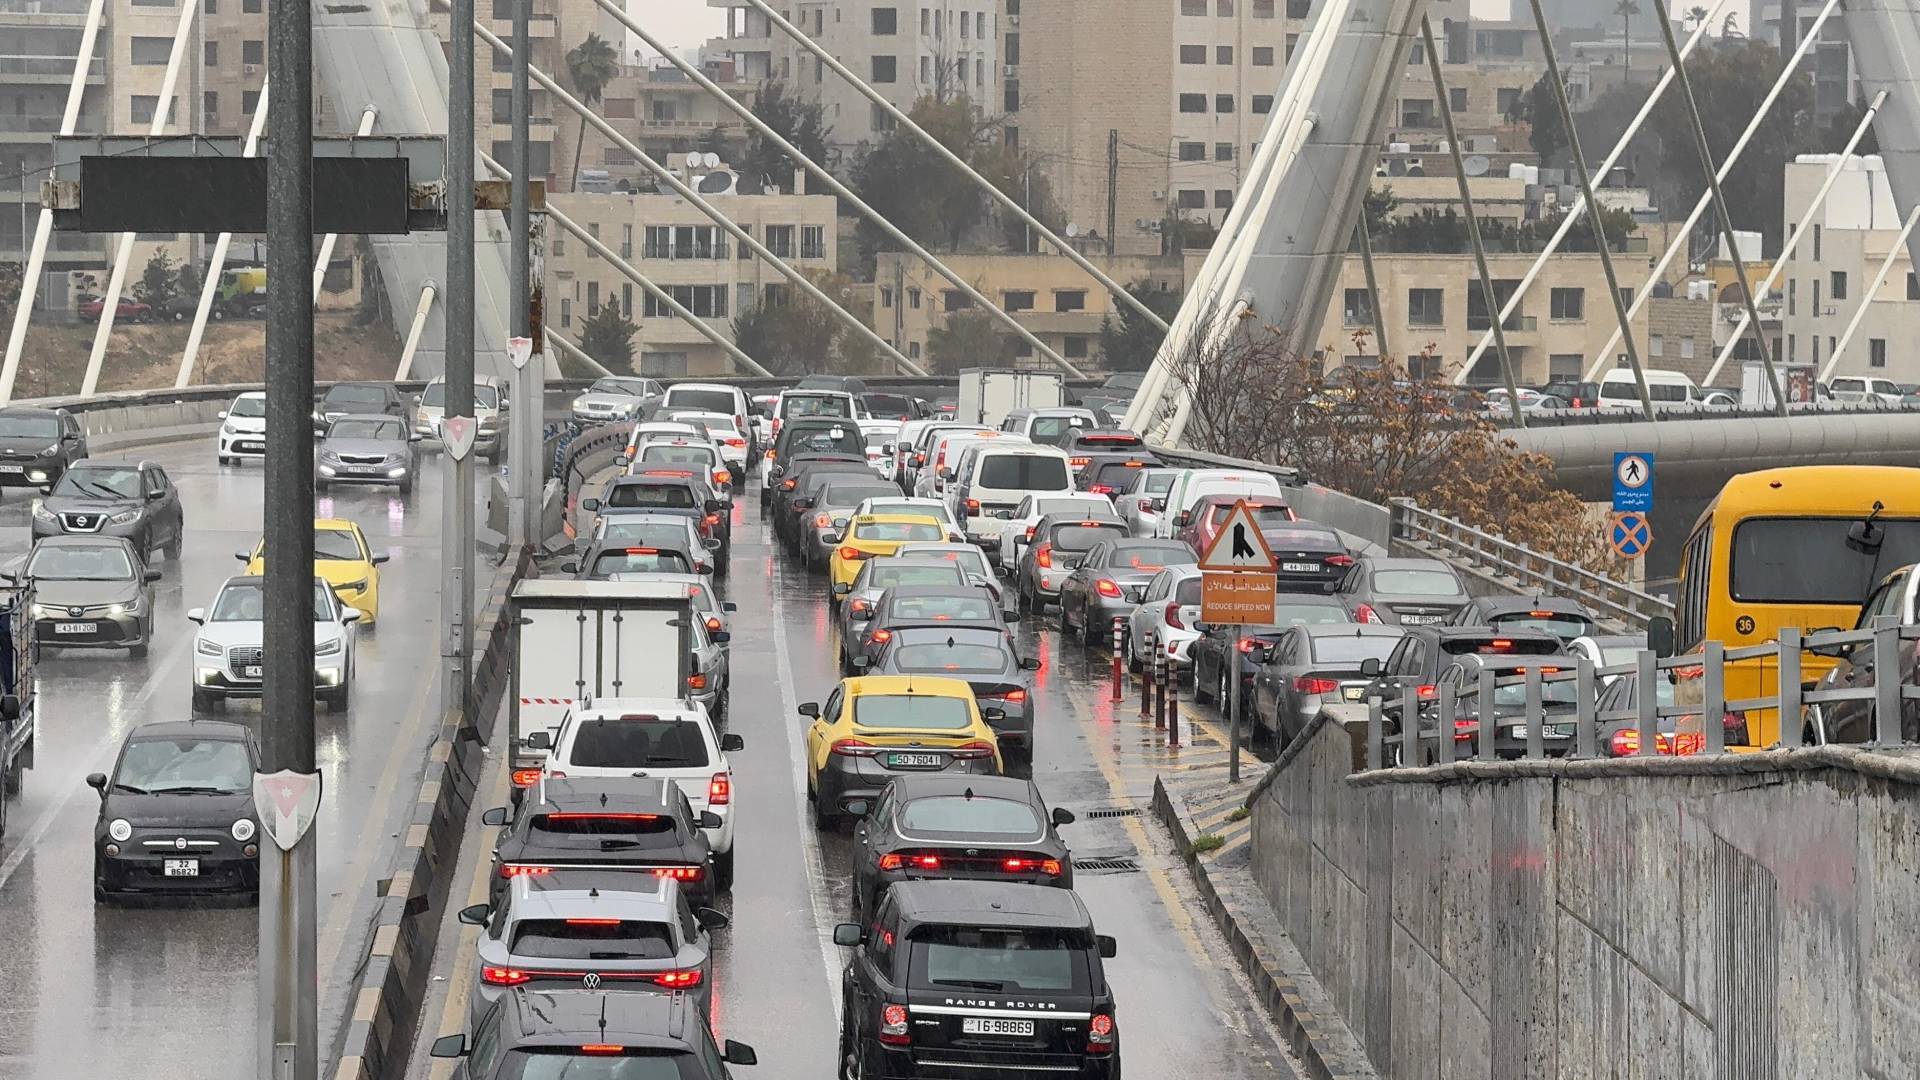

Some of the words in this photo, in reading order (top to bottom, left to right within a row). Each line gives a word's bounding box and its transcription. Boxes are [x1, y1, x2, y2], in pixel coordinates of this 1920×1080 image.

[1206, 602, 1233, 610] REDUCE
[1233, 603, 1255, 611] SPEED
[1255, 604, 1271, 612] NOW
[1739, 620, 1752, 631] 36
[945, 998, 996, 1008] RANGE
[1007, 1001, 1057, 1010] ROVER
